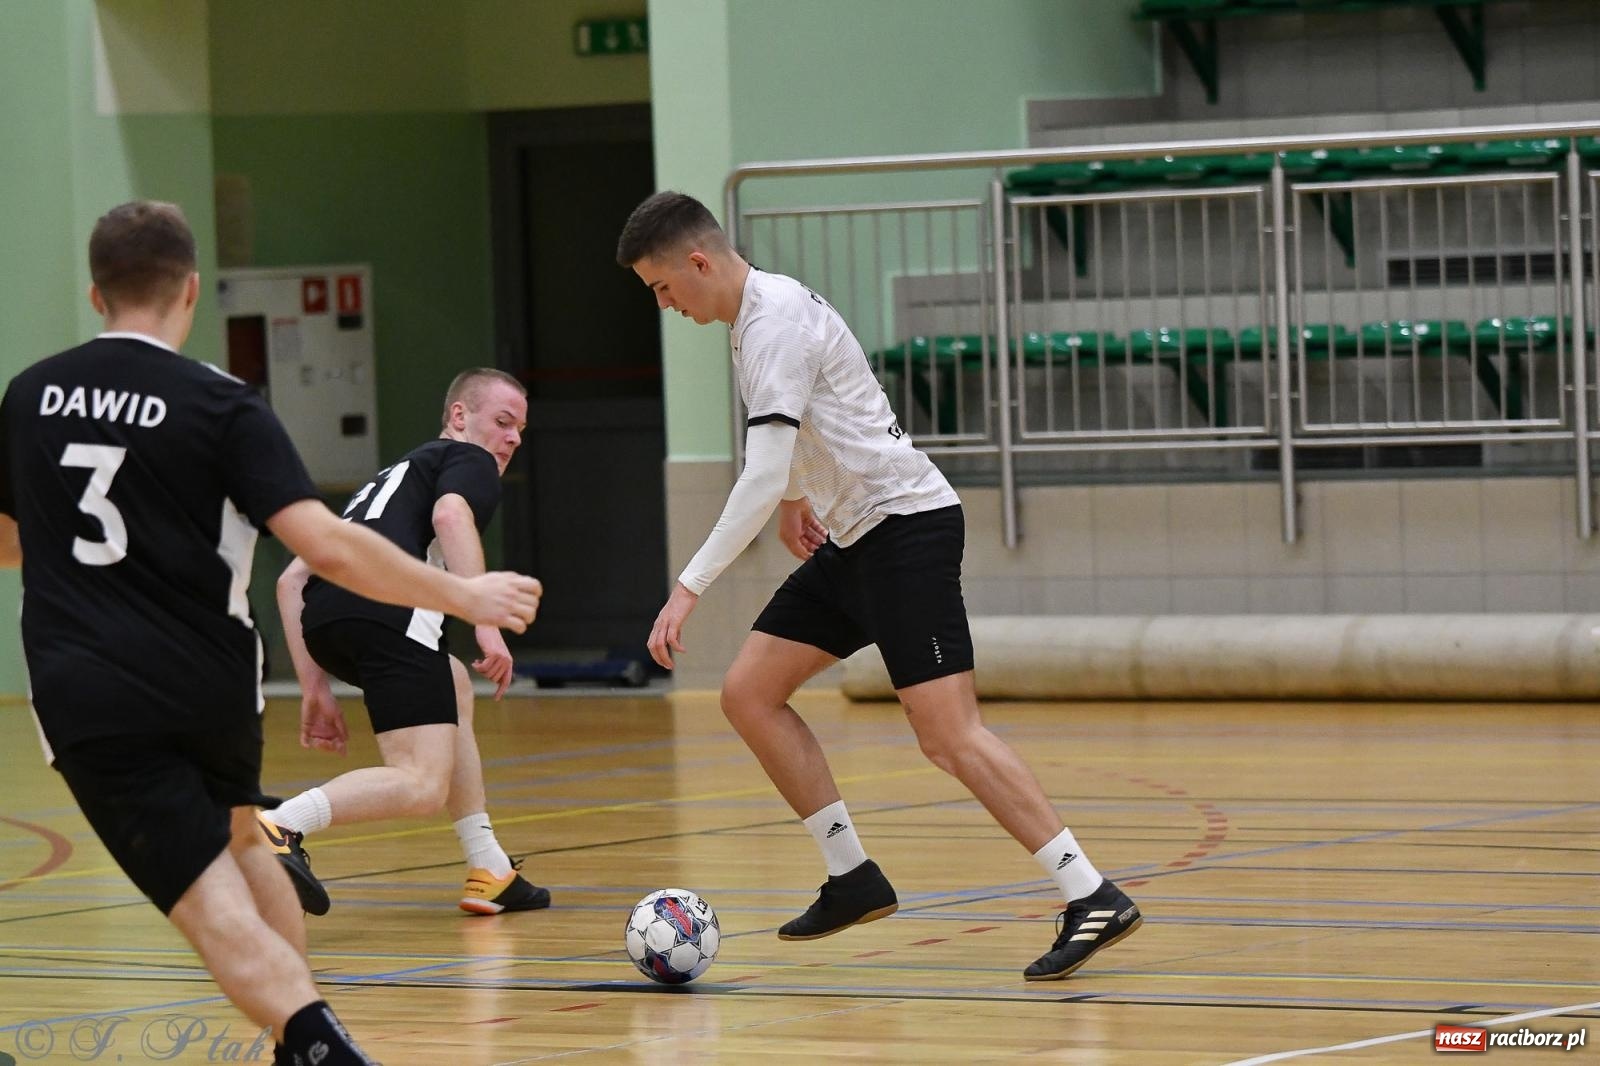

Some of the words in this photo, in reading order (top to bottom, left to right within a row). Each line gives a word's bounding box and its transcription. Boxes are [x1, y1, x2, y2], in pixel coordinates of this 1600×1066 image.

[39, 384, 167, 428] DAWID
[59, 442, 129, 567] 3
[826, 824, 848, 839] adidas
